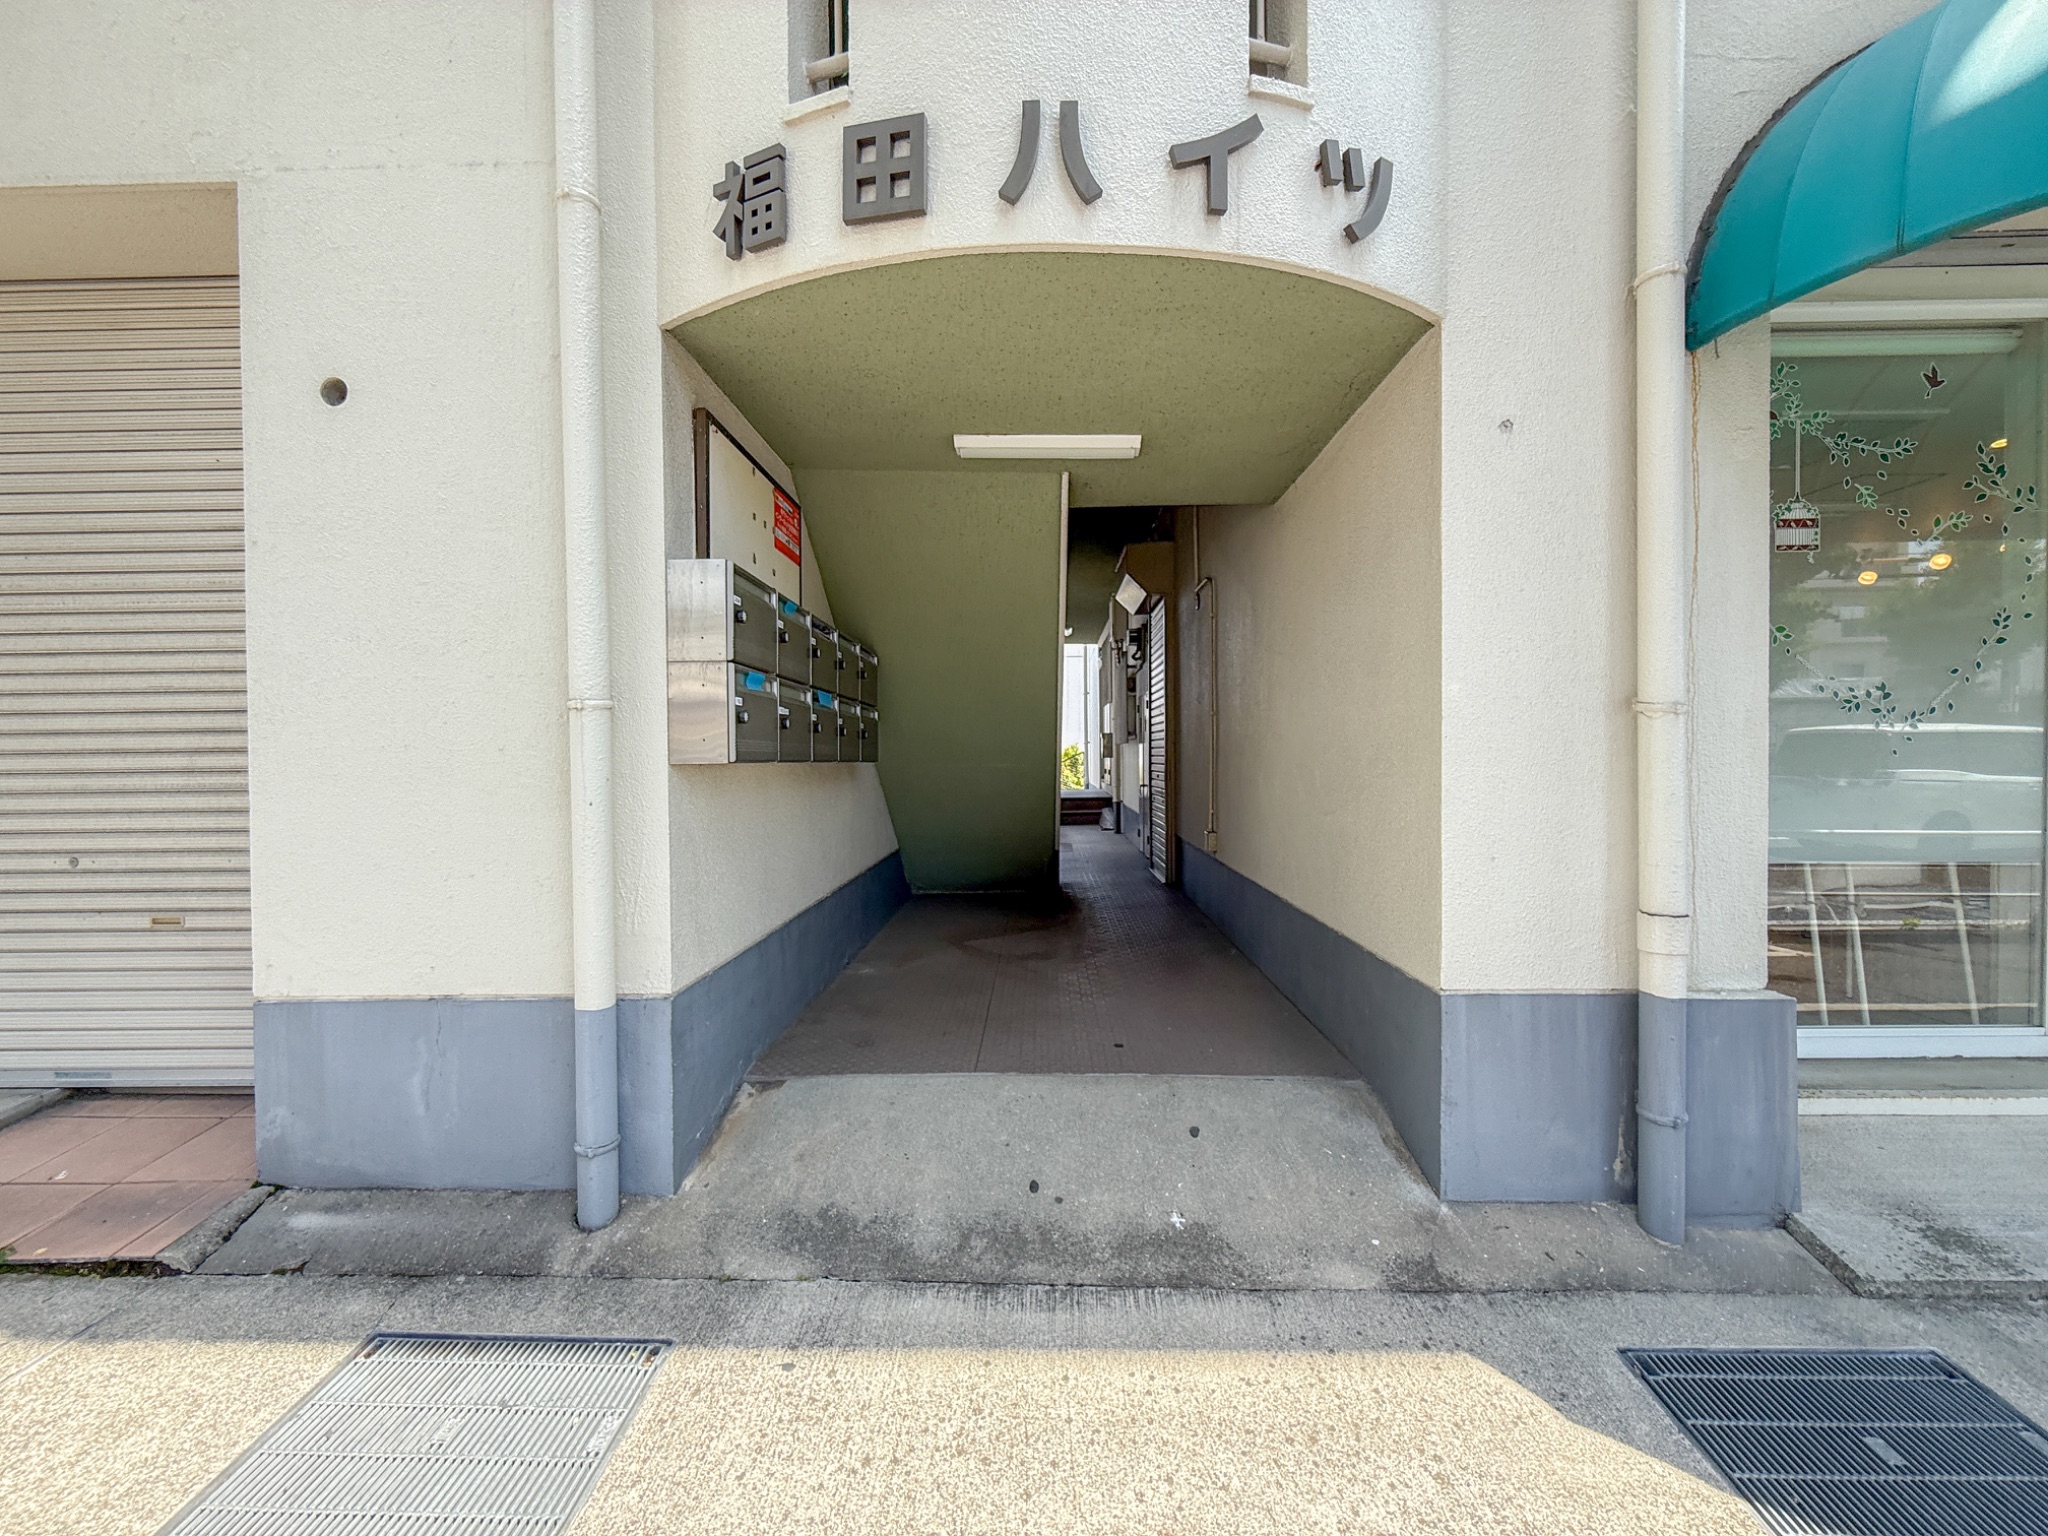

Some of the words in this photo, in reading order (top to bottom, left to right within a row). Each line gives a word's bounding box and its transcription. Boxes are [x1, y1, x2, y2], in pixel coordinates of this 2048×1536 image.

[713, 100, 1393, 260] 福田ハイツ
